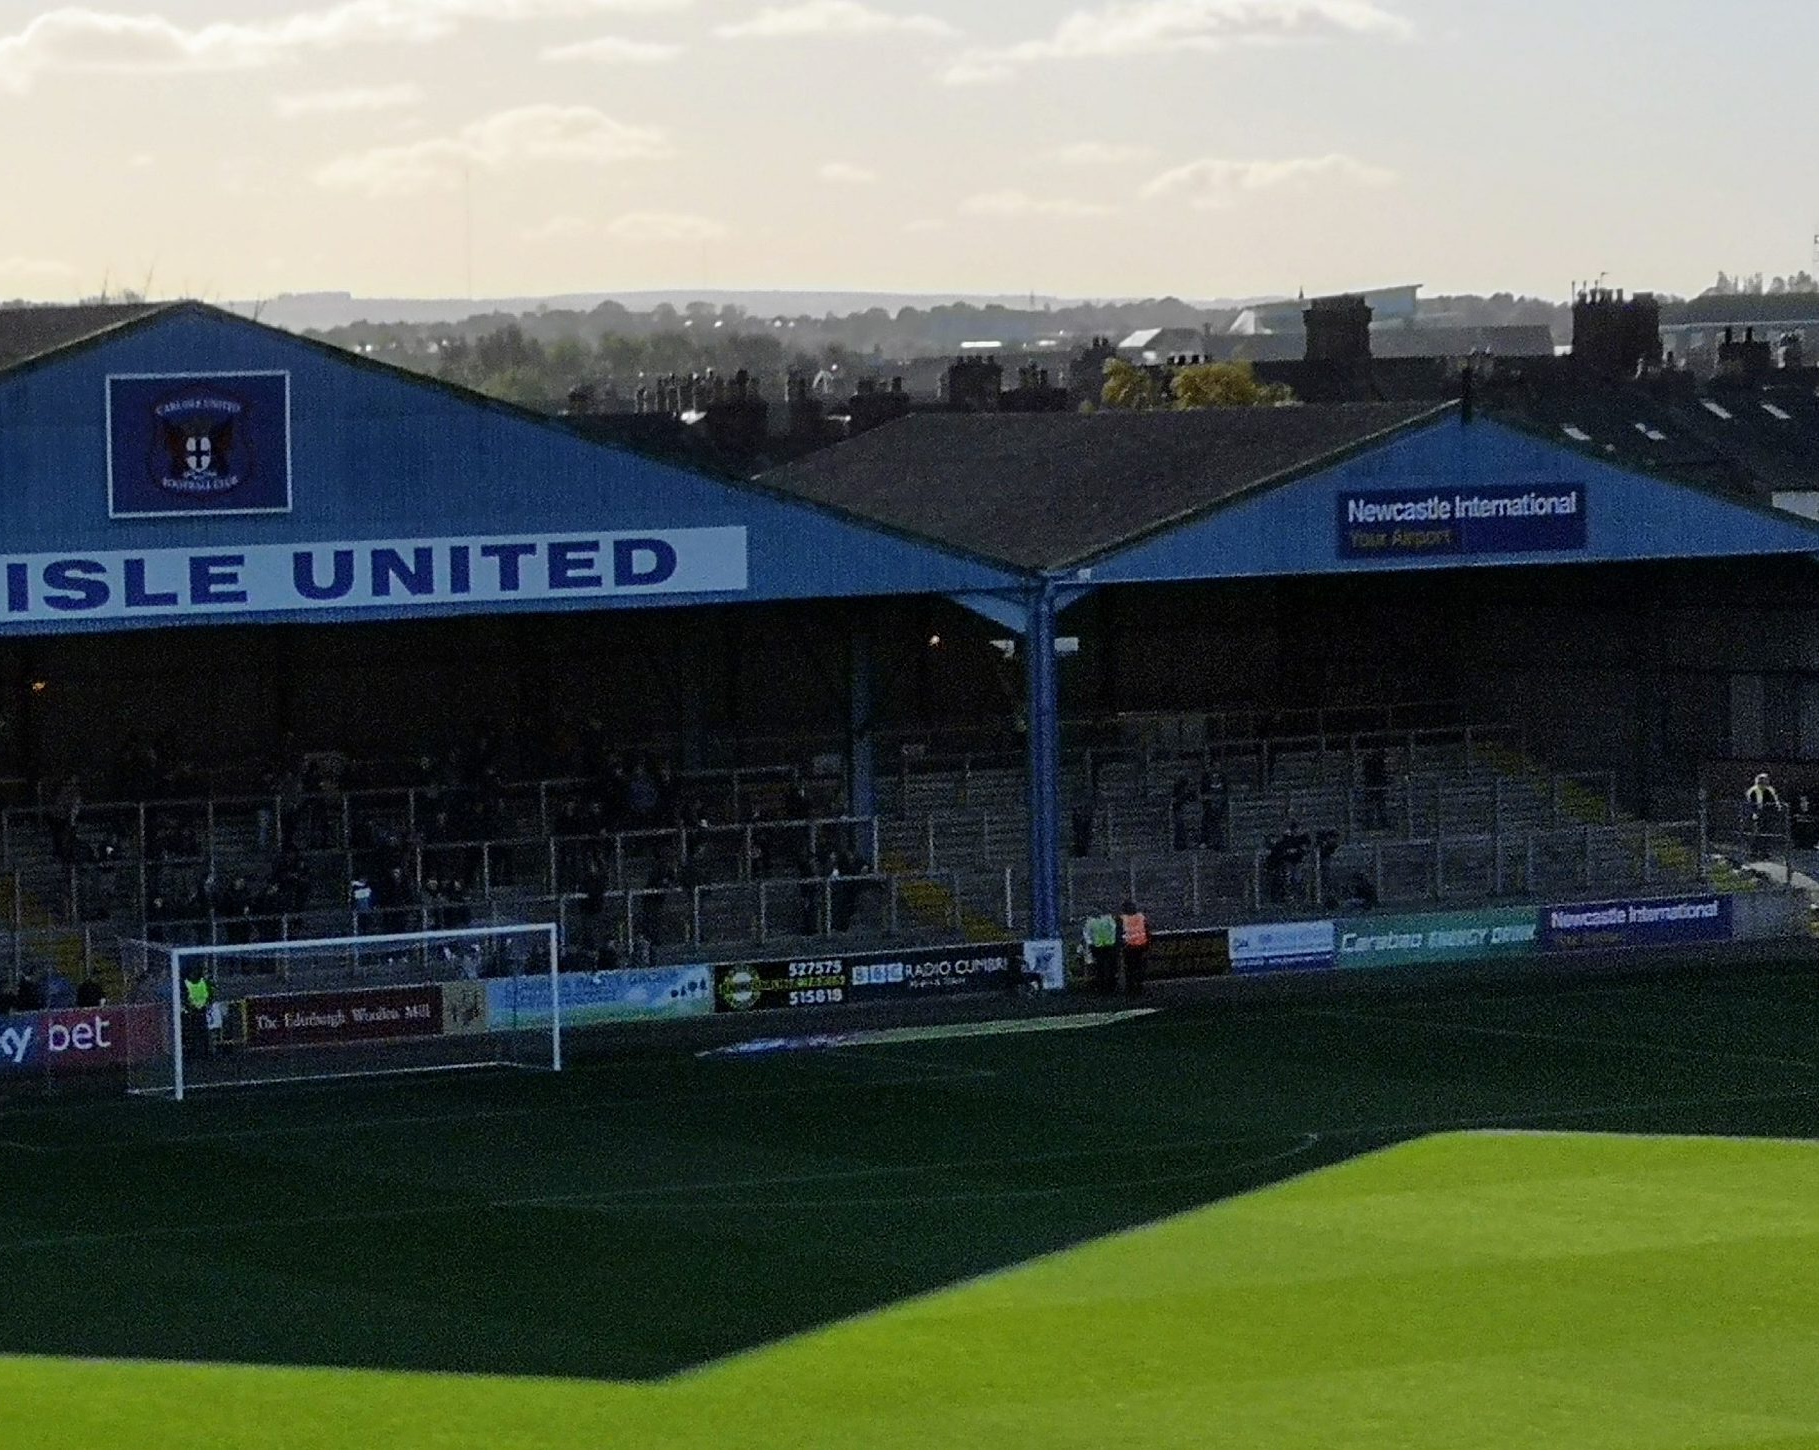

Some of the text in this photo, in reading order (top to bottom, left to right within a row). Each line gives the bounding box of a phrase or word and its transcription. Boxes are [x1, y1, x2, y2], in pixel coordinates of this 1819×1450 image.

[203, 399, 242, 413] UNITED
[1348, 489, 1577, 524] Newcastle International
[1350, 526, 1453, 550] Your Airport
[292, 538, 677, 600] UNITED
[1551, 899, 1719, 929] Newcastle International
[905, 960, 952, 979] RADIO
[256, 1003, 431, 1029] The Edinburgh Woollen Mill
[48, 1016, 112, 1052] bet
